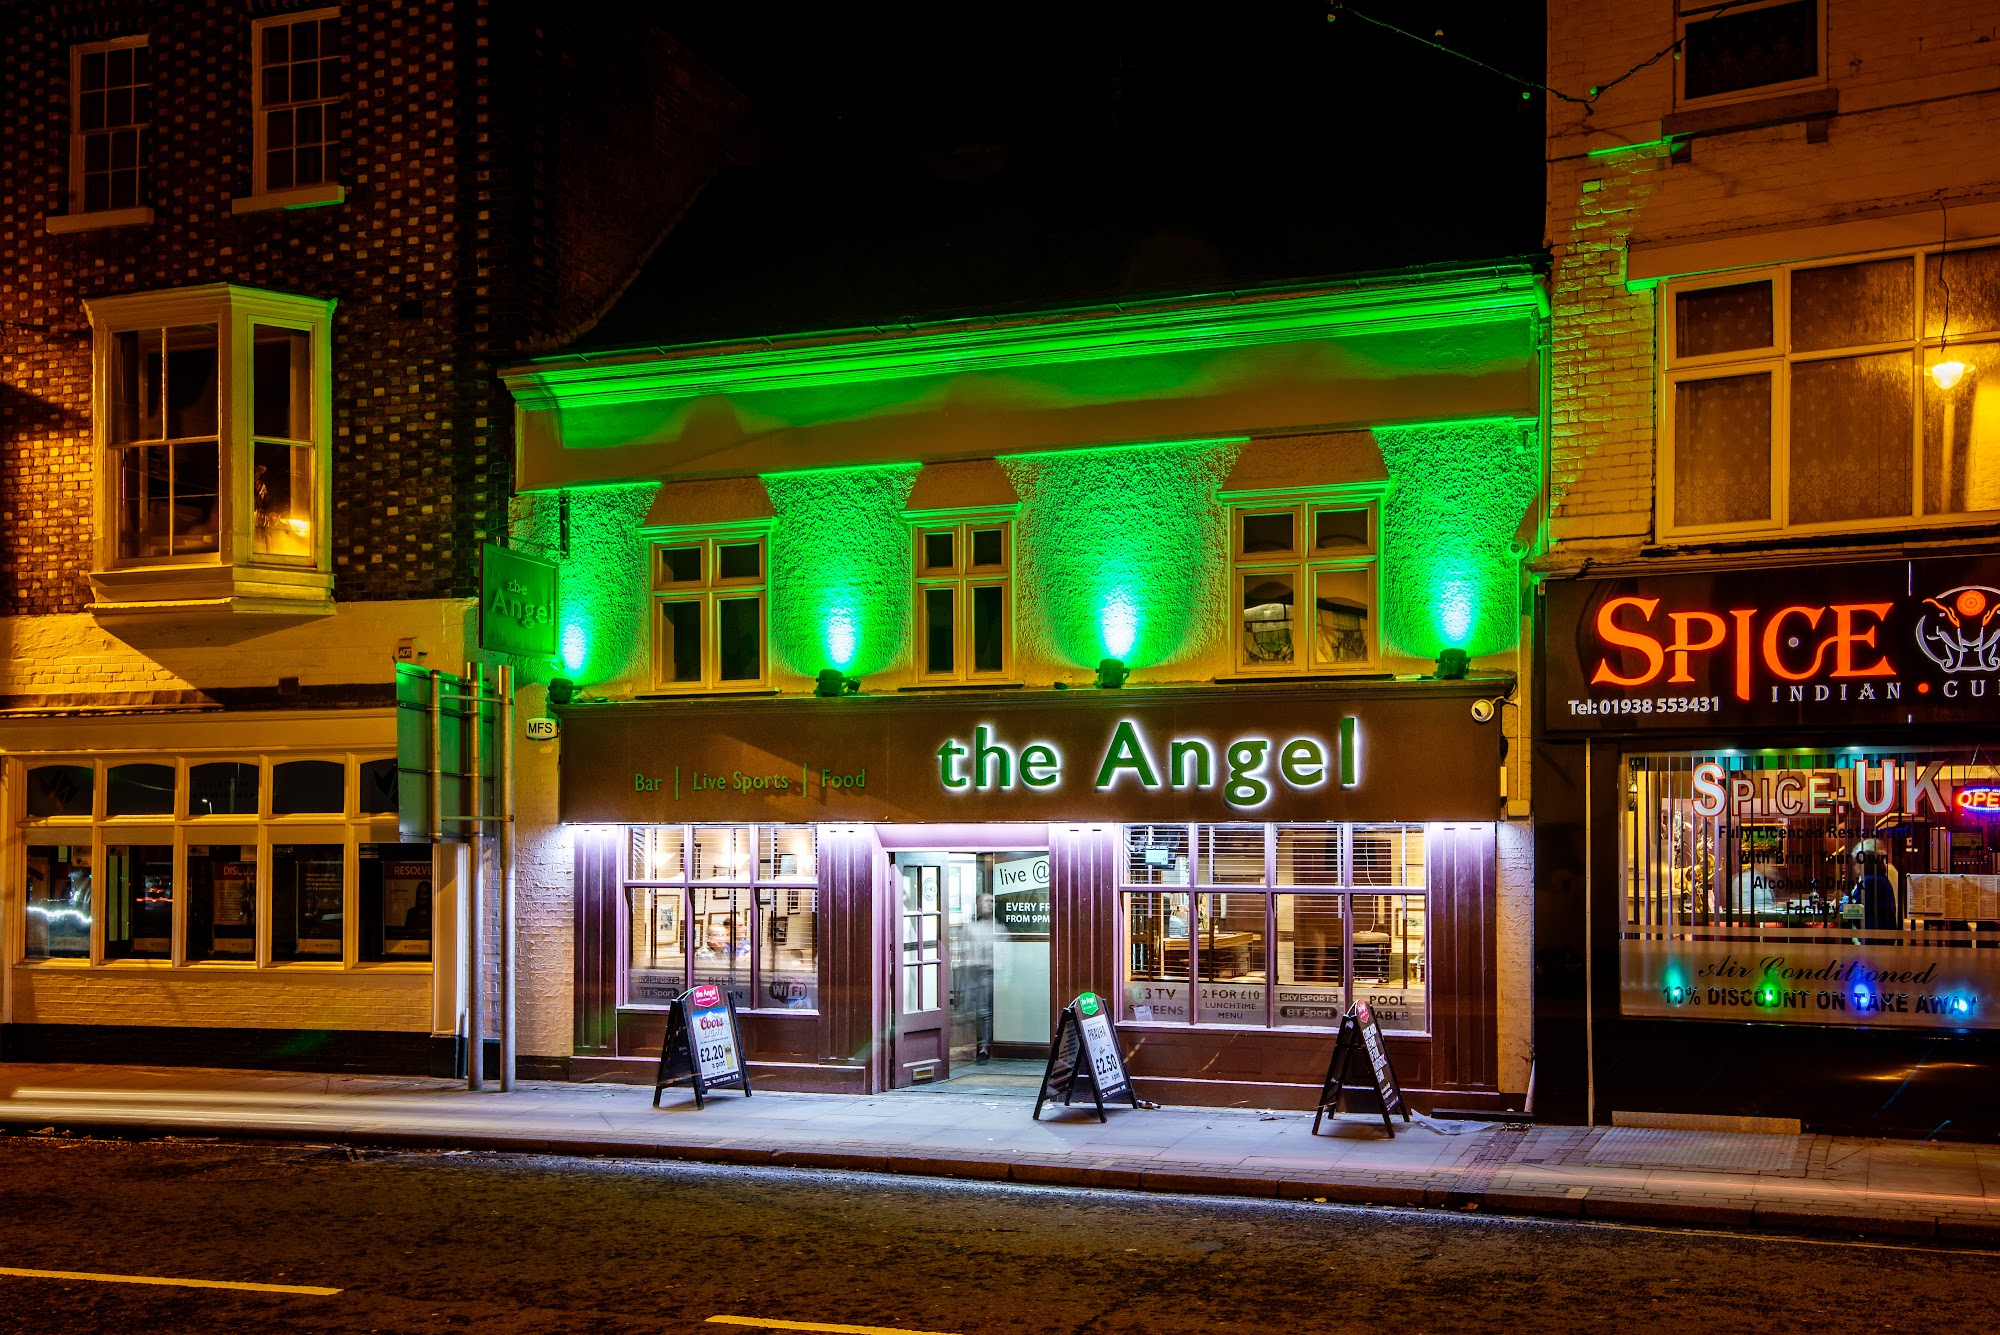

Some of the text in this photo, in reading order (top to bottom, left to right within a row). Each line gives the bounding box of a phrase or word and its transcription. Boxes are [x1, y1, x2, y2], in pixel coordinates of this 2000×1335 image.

[508, 579, 527, 595] the
[491, 588, 554, 628] Angel
[1591, 596, 1896, 700] SPICE
[1771, 679, 2000, 702] INDIAN CU
[1567, 696, 1719, 715] Tel: 01938 553431
[528, 722, 553, 734] MFS
[936, 716, 1356, 807] the Angel
[634, 768, 866, 794] Bar Live Sports Food
[1719, 825, 1753, 841] Fully
[1856, 851, 1889, 864] Own
[999, 868, 1027, 886] live
[1005, 902, 1037, 912] EVERY
[1005, 914, 1050, 923] FROM 9PM
[1698, 954, 1938, 985] Air Conditioned
[1145, 987, 1176, 1000] 3 TV
[1201, 988, 1260, 1000] 2 FOR £10
[1280, 993, 1337, 1002] SKY SPORTS
[1369, 995, 1407, 1006] POOL
[1708, 986, 1810, 1009] DISCOUNT
[1817, 990, 1846, 1010] ON
[1854, 991, 1909, 1013] TAKE
[1915, 993, 1979, 1015] AWAY
[1205, 1001, 1257, 1010] LUNCHTIME
[1286, 1007, 1332, 1018] BT Sport
[1217, 1011, 1243, 1020] MENU
[1374, 1011, 1409, 1021] ABLE
[699, 1016, 725, 1031] Coors
[700, 1044, 724, 1063] £2.20
[1095, 1053, 1118, 1076] £2.50
